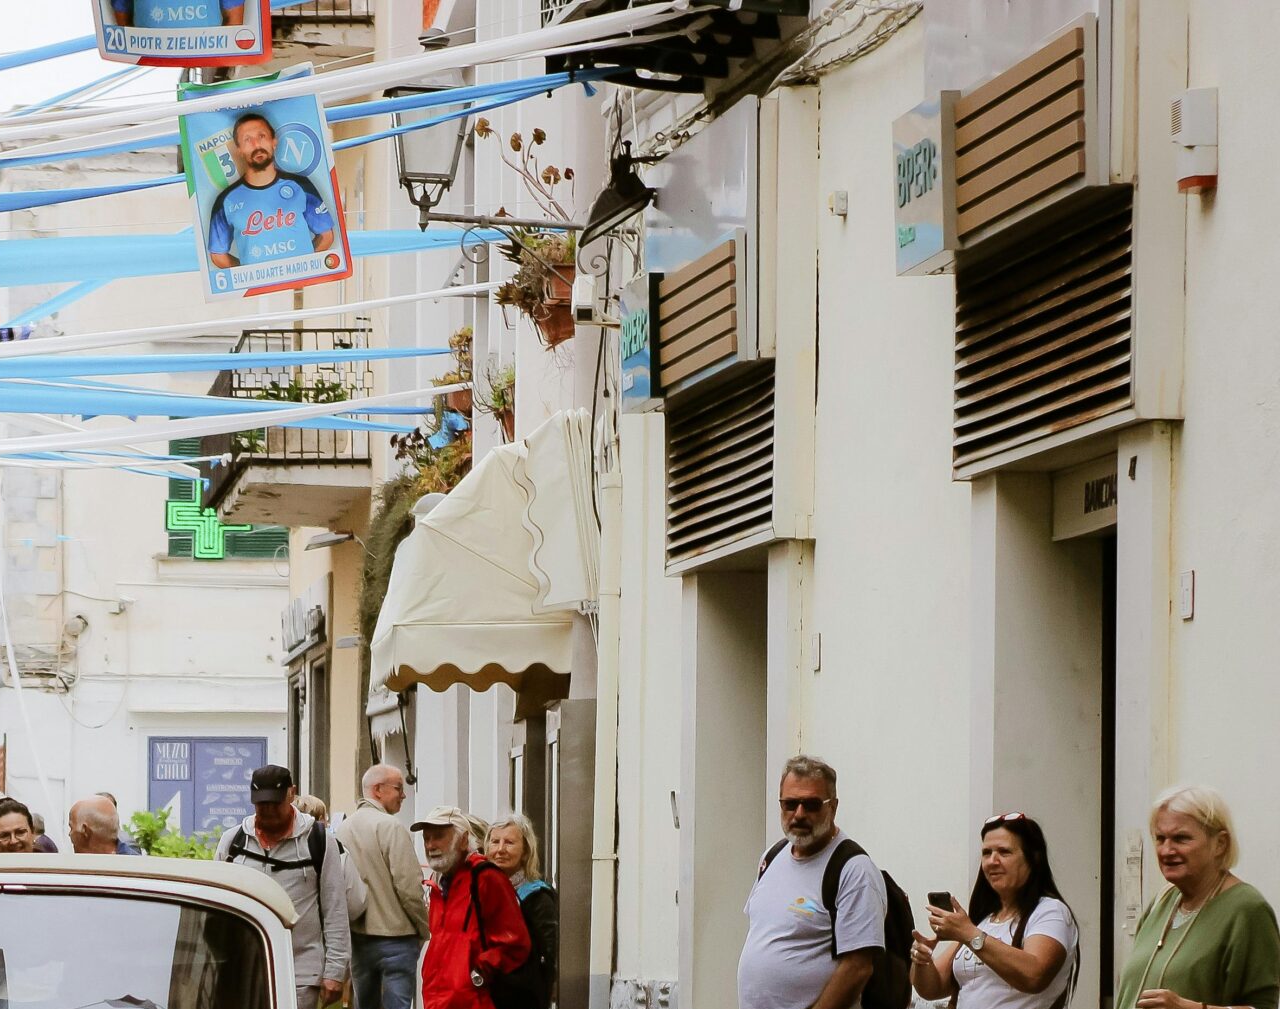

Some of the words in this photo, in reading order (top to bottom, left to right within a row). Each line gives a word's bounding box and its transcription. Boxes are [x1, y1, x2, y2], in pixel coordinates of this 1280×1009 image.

[168, 4, 208, 21] MSC
[106, 28, 126, 50] 20
[130, 36, 162, 50] PIOTR
[219, 153, 236, 178] 3
[242, 208, 296, 236] Lete
[264, 240, 296, 256] MSC
[216, 272, 227, 289] 6
[234, 272, 254, 284] SILVA
[256, 266, 284, 280] DUARTE
[286, 262, 308, 275] MARIO
[311, 260, 322, 270] RUI
